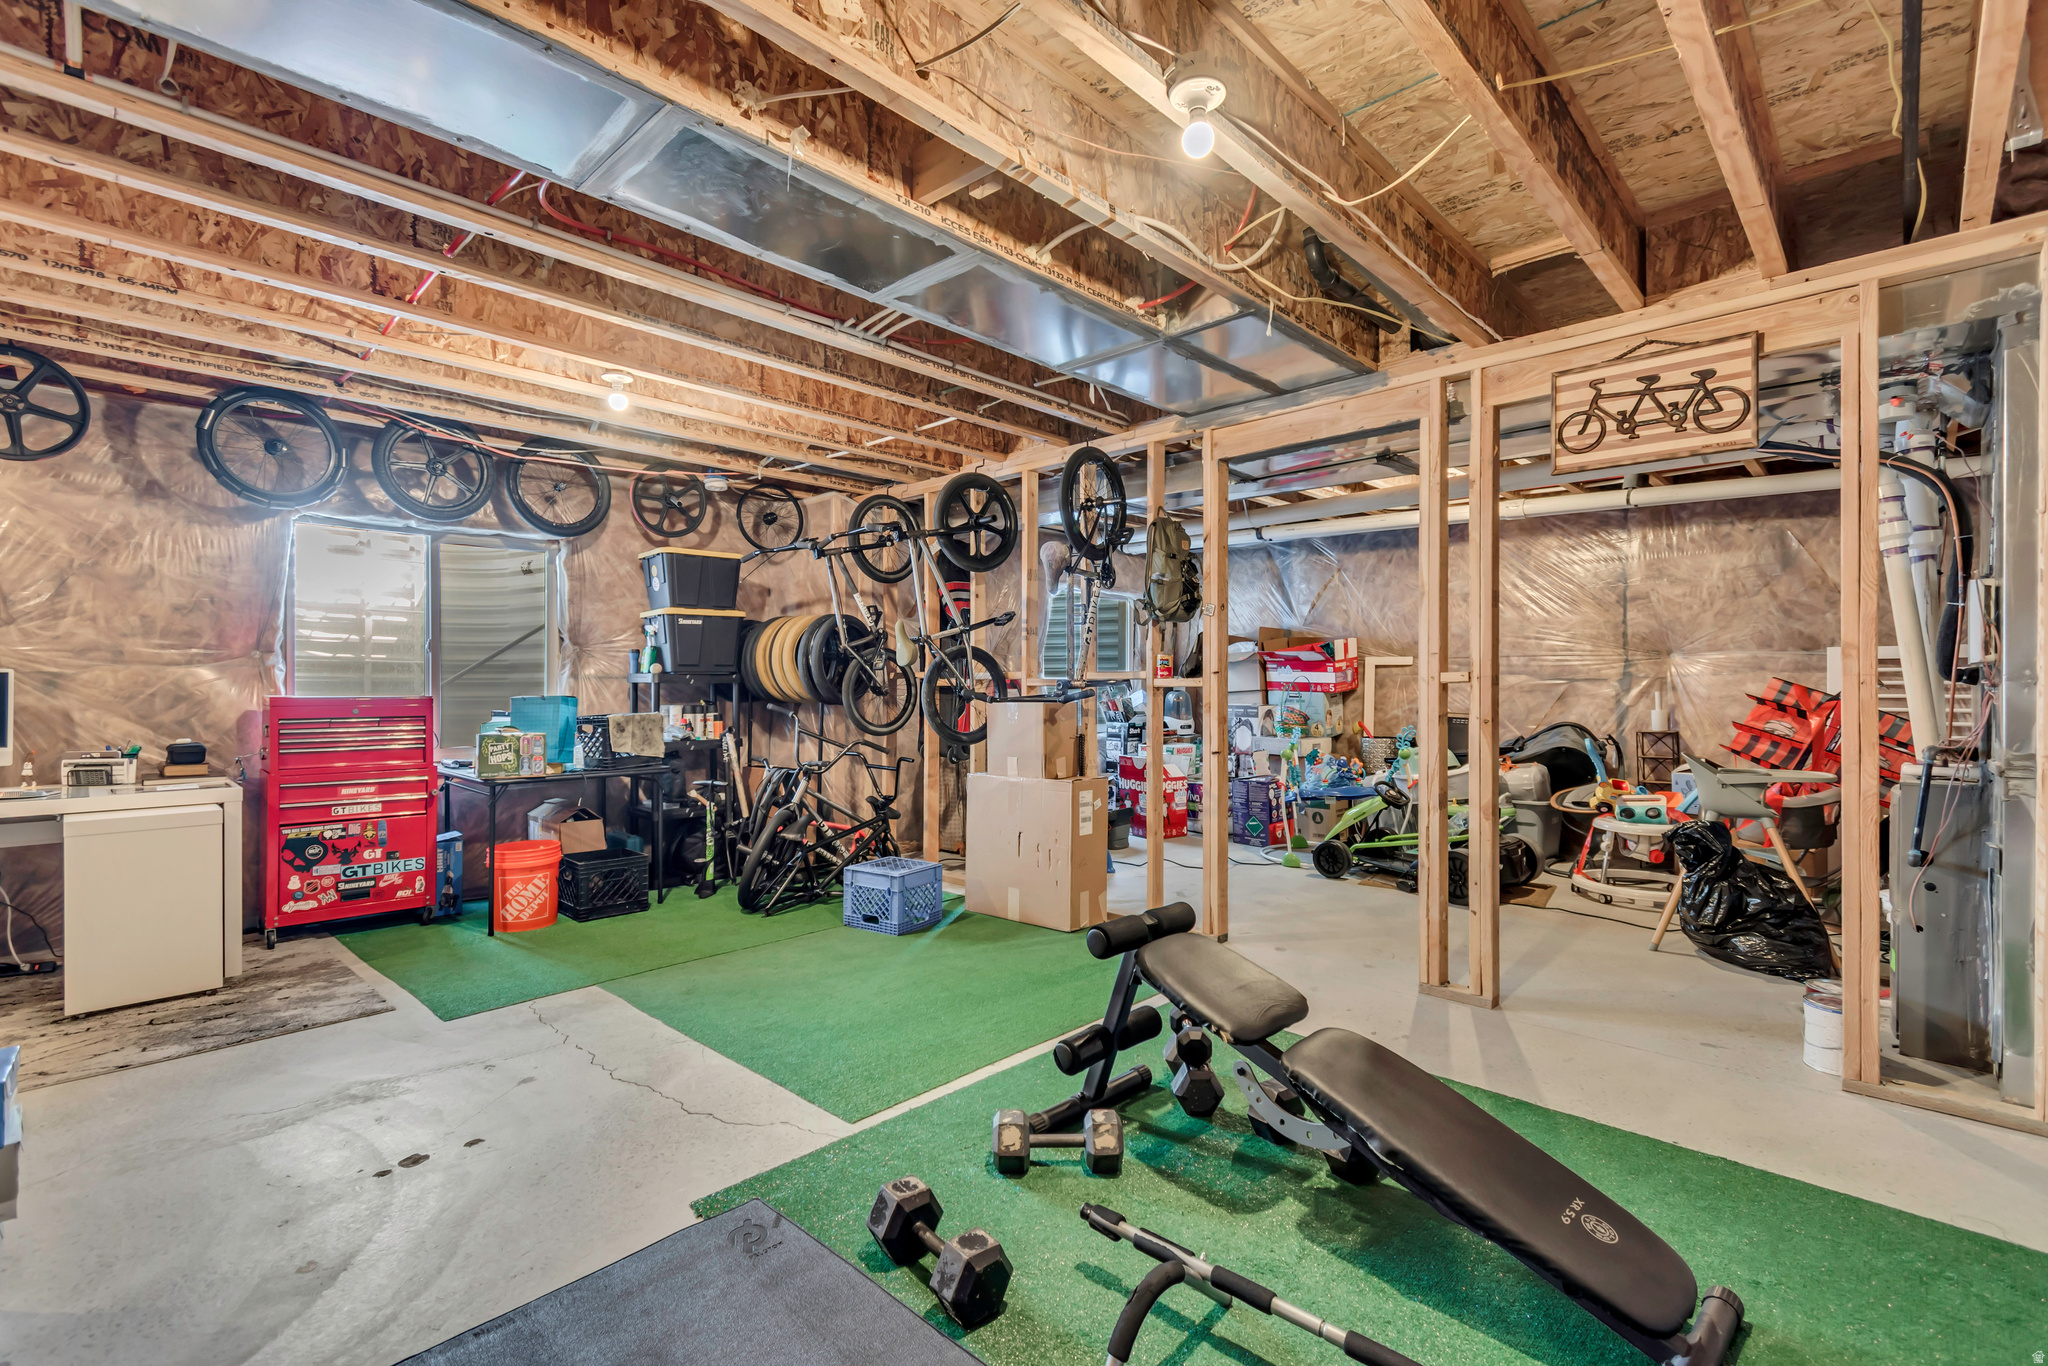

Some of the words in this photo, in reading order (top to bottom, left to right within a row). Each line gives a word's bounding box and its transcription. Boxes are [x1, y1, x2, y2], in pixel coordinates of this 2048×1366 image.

[896, 194, 911, 207] TJI
[913, 203, 931, 218] 210
[940, 216, 970, 236] ICCES
[972, 231, 992, 247] ESR
[1087, 287, 1124, 310] CERTIFIED
[0, 250, 28, 262] 570
[42, 258, 105, 279] 12/19/18
[118, 276, 178, 295] 05:44PM
[1244, 283, 1270, 304] SOURCIN
[148, 351, 166, 360] SFI
[170, 356, 232, 373] CERTIFIED
[236, 370, 296, 385] SOURCING
[298, 380, 328, 390] 00008
[819, 366, 858, 382] CERTIFIED
[860, 378, 896, 395] SOURCING
[1330, 684, 1335, 692] 5
[490, 744, 510, 752] PARTY
[490, 752, 512, 764] HOPS
[1119, 778, 1146, 792] HUGGIE
[1163, 780, 1188, 791] GGIES
[1182, 826, 1187, 834] 4
[363, 848, 383, 860] GT
[342, 858, 425, 878] GTBIKES
[501, 874, 549, 922] HOME
[504, 881, 526, 900] THE
[518, 890, 548, 920] DEPOT
[1570, 1197, 1585, 1211] XR
[1561, 1208, 1576, 1224] 5.9
